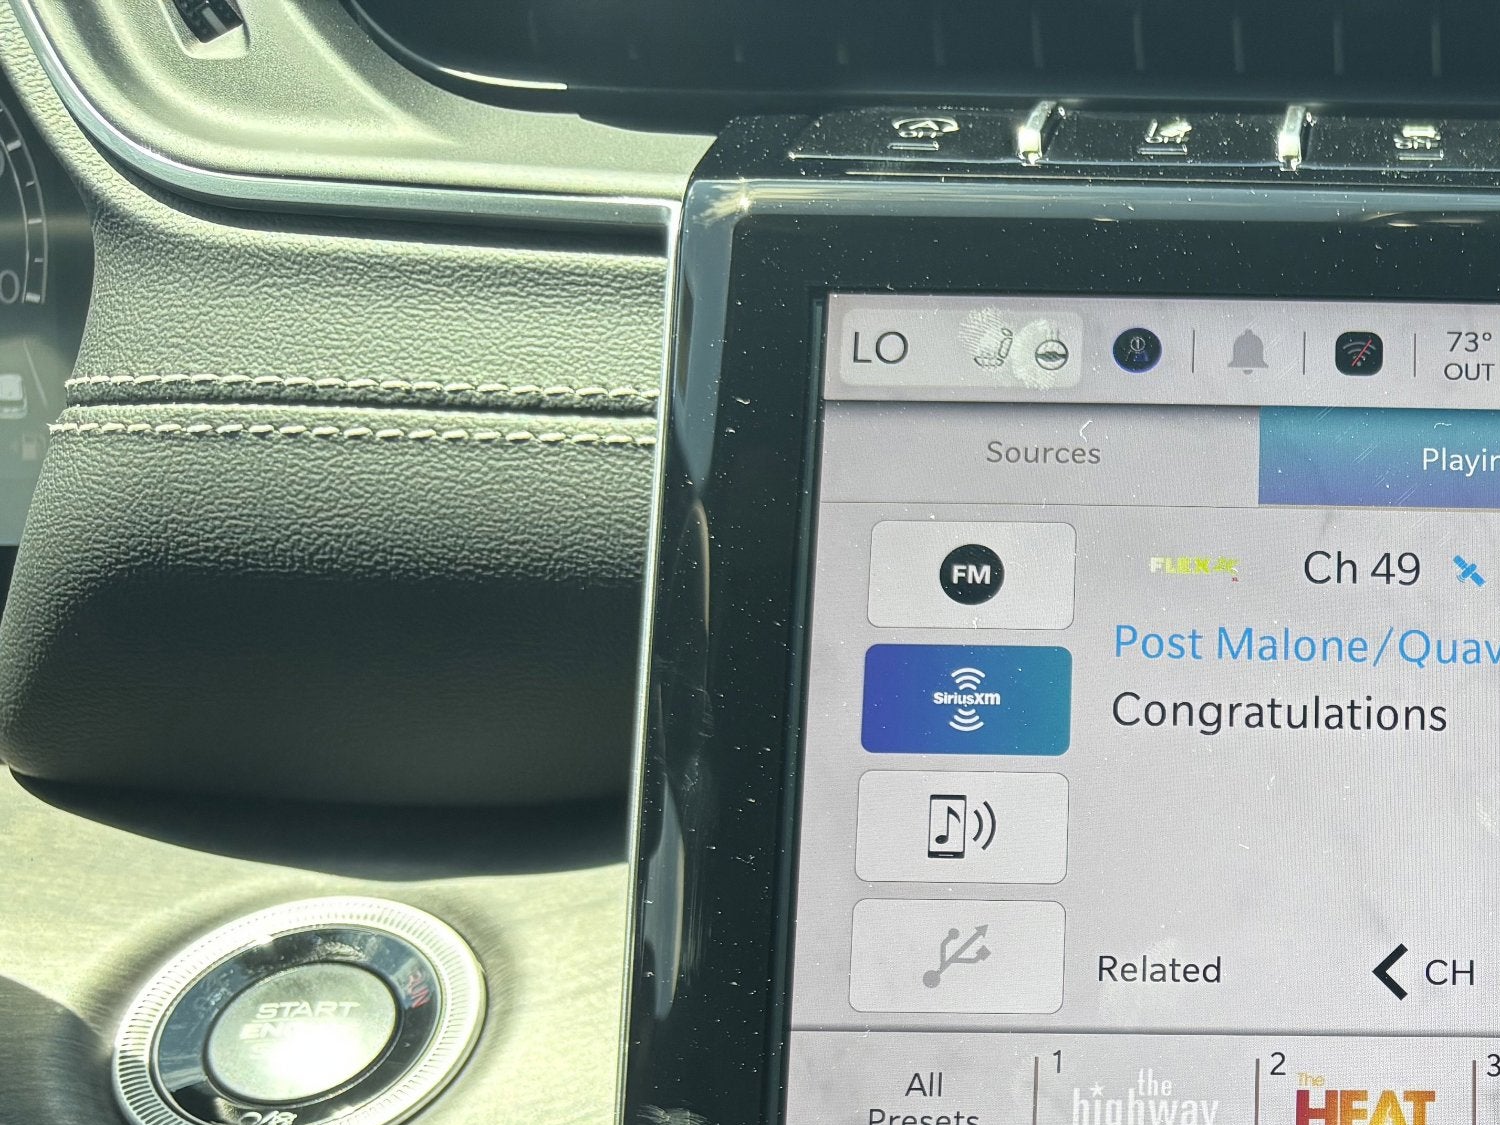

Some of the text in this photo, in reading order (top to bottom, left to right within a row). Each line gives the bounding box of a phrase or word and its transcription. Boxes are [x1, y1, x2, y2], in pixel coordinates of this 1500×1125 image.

[852, 330, 908, 366] LO
[1446, 331, 1493, 354] 73°
[1443, 362, 1496, 382] OUT
[985, 439, 1101, 467] Sources
[952, 562, 992, 585] FM
[1303, 551, 1421, 586] Ch 49
[1115, 626, 1202, 661] Post
[1112, 692, 1448, 736] Congratulations
[1097, 953, 1222, 985] Related
[1425, 958, 1476, 987] CH
[256, 1001, 360, 1019] START
[1053, 1050, 1063, 1074] 1
[1270, 1053, 1286, 1075] 2
[904, 1071, 943, 1098] All
[1138, 1068, 1173, 1097] the
[1296, 1072, 1325, 1087] The
